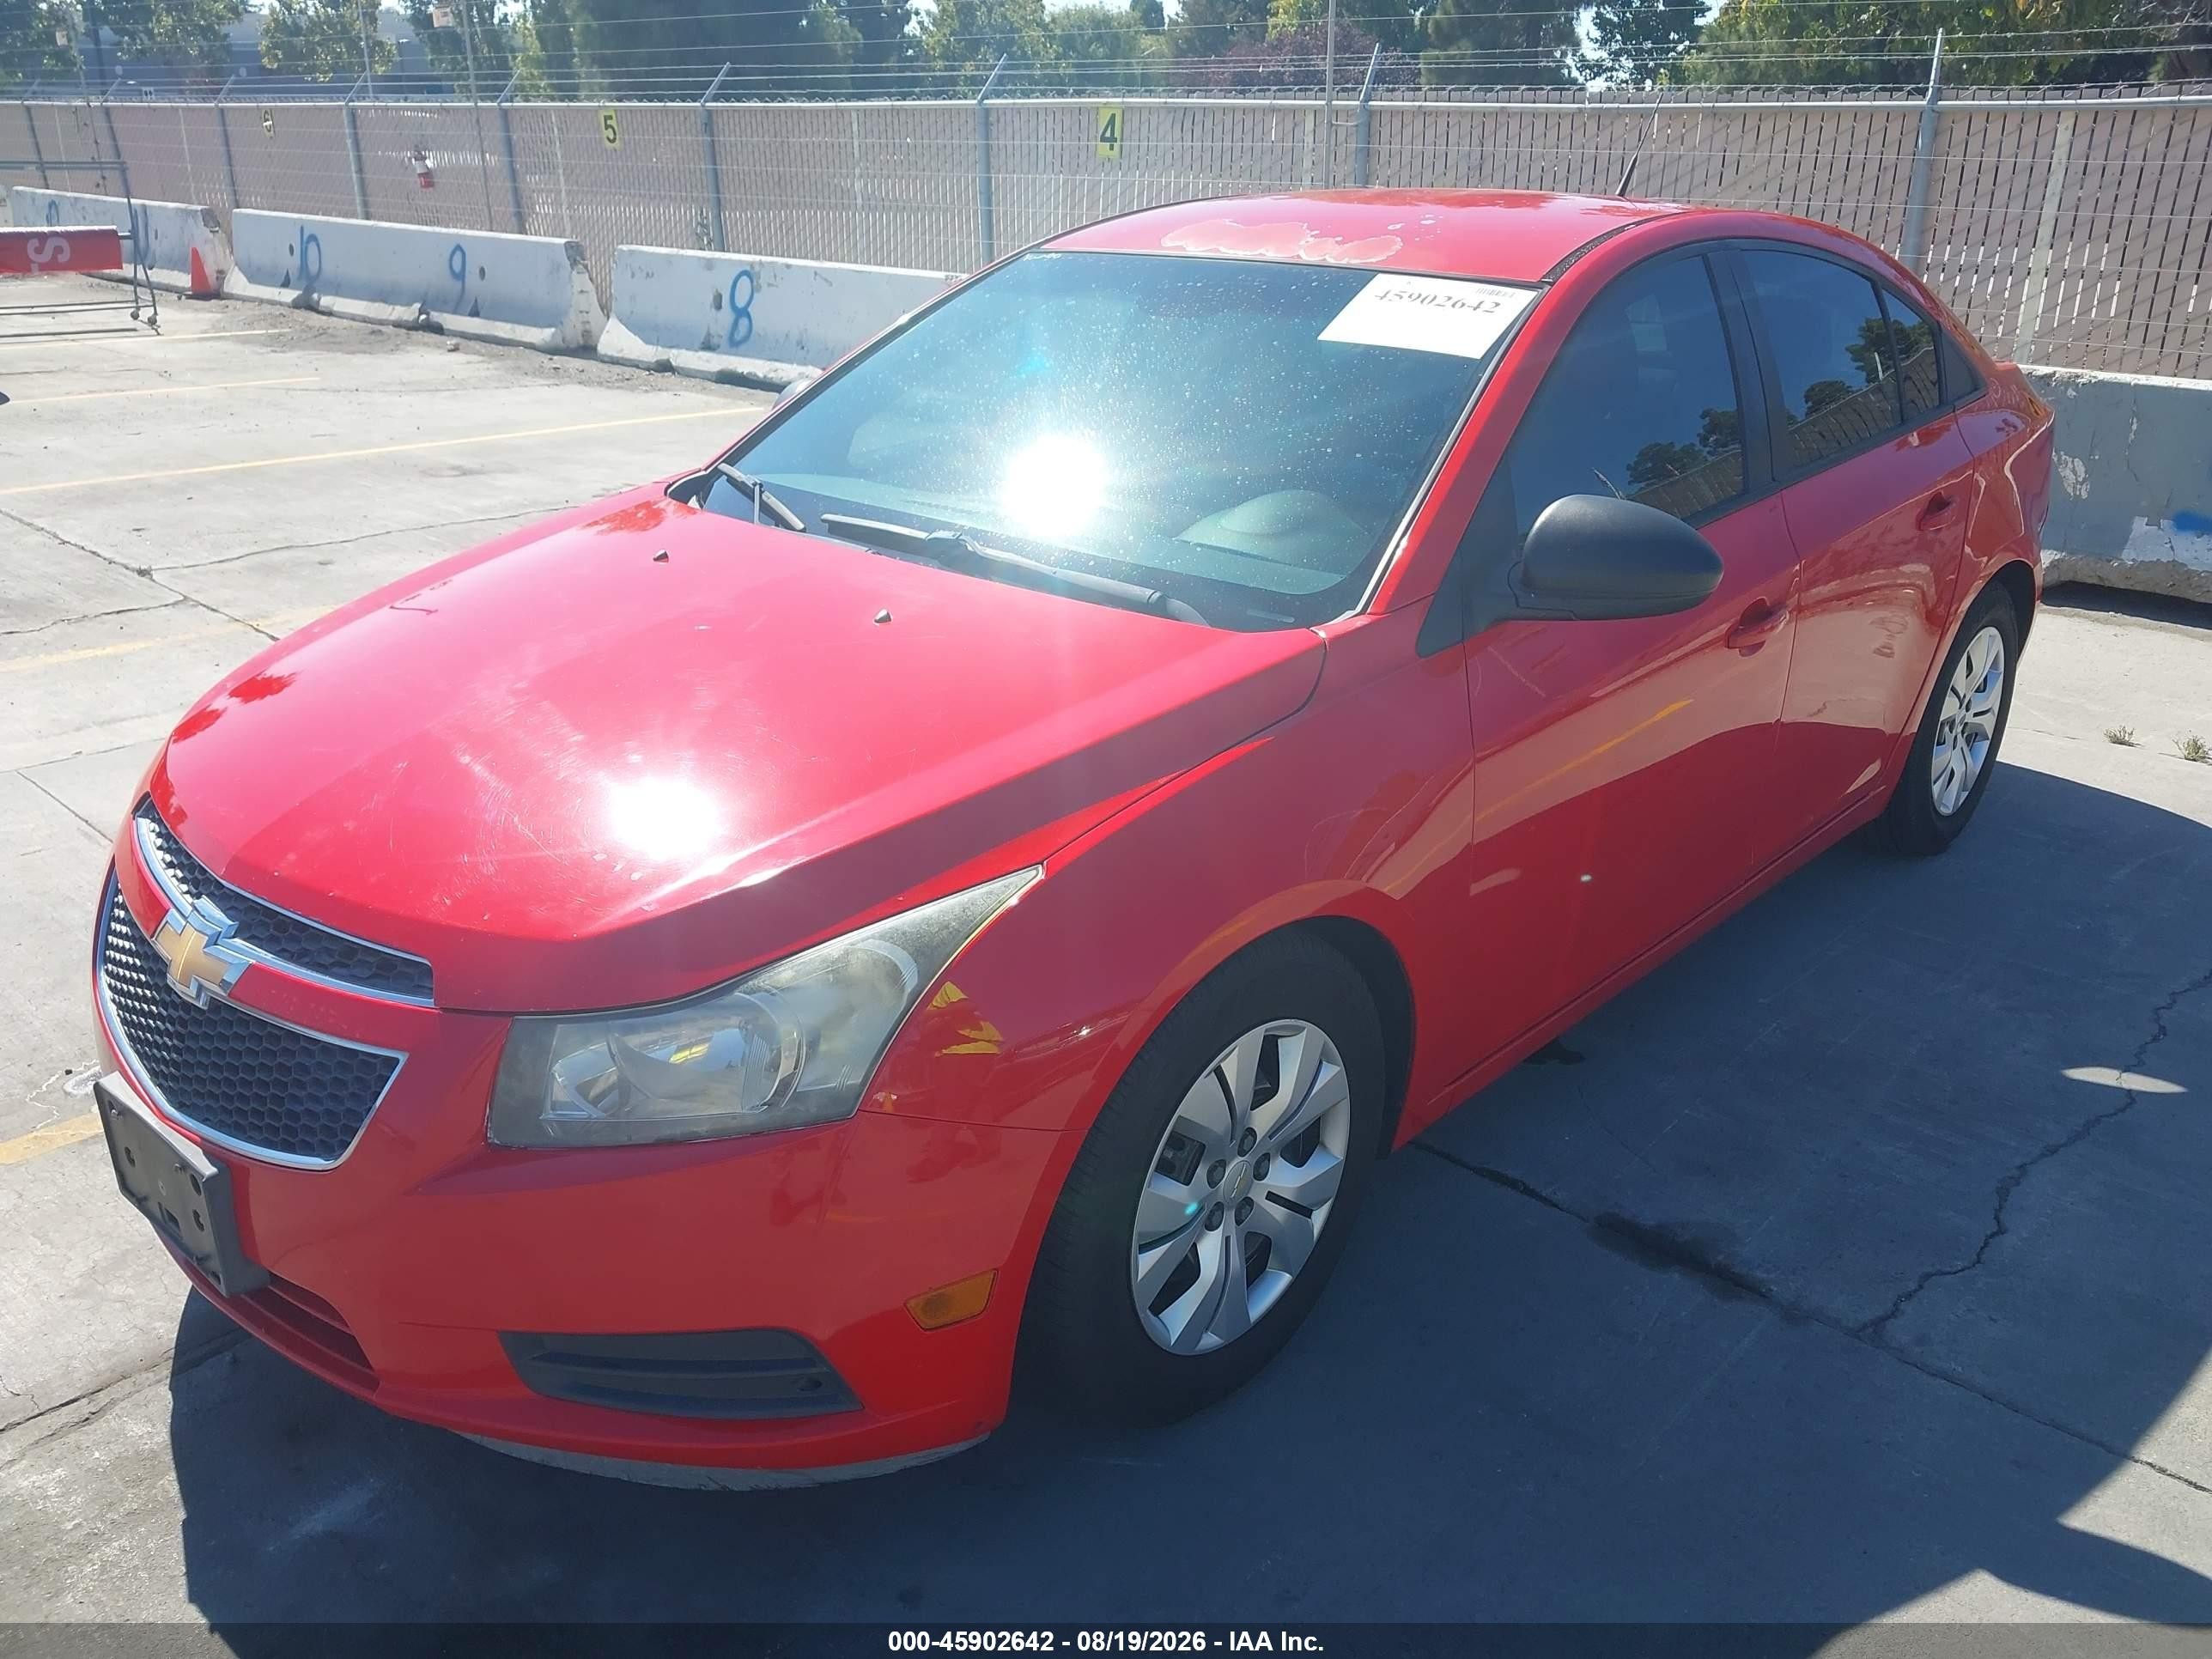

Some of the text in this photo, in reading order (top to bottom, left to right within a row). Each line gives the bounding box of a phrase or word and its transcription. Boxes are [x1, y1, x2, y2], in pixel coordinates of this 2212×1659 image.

[603, 114, 617, 144] 5
[1100, 112, 1118, 152] 4
[449, 243, 467, 314] 9
[728, 269, 755, 349] 8
[1374, 289, 1501, 313] 45902642
